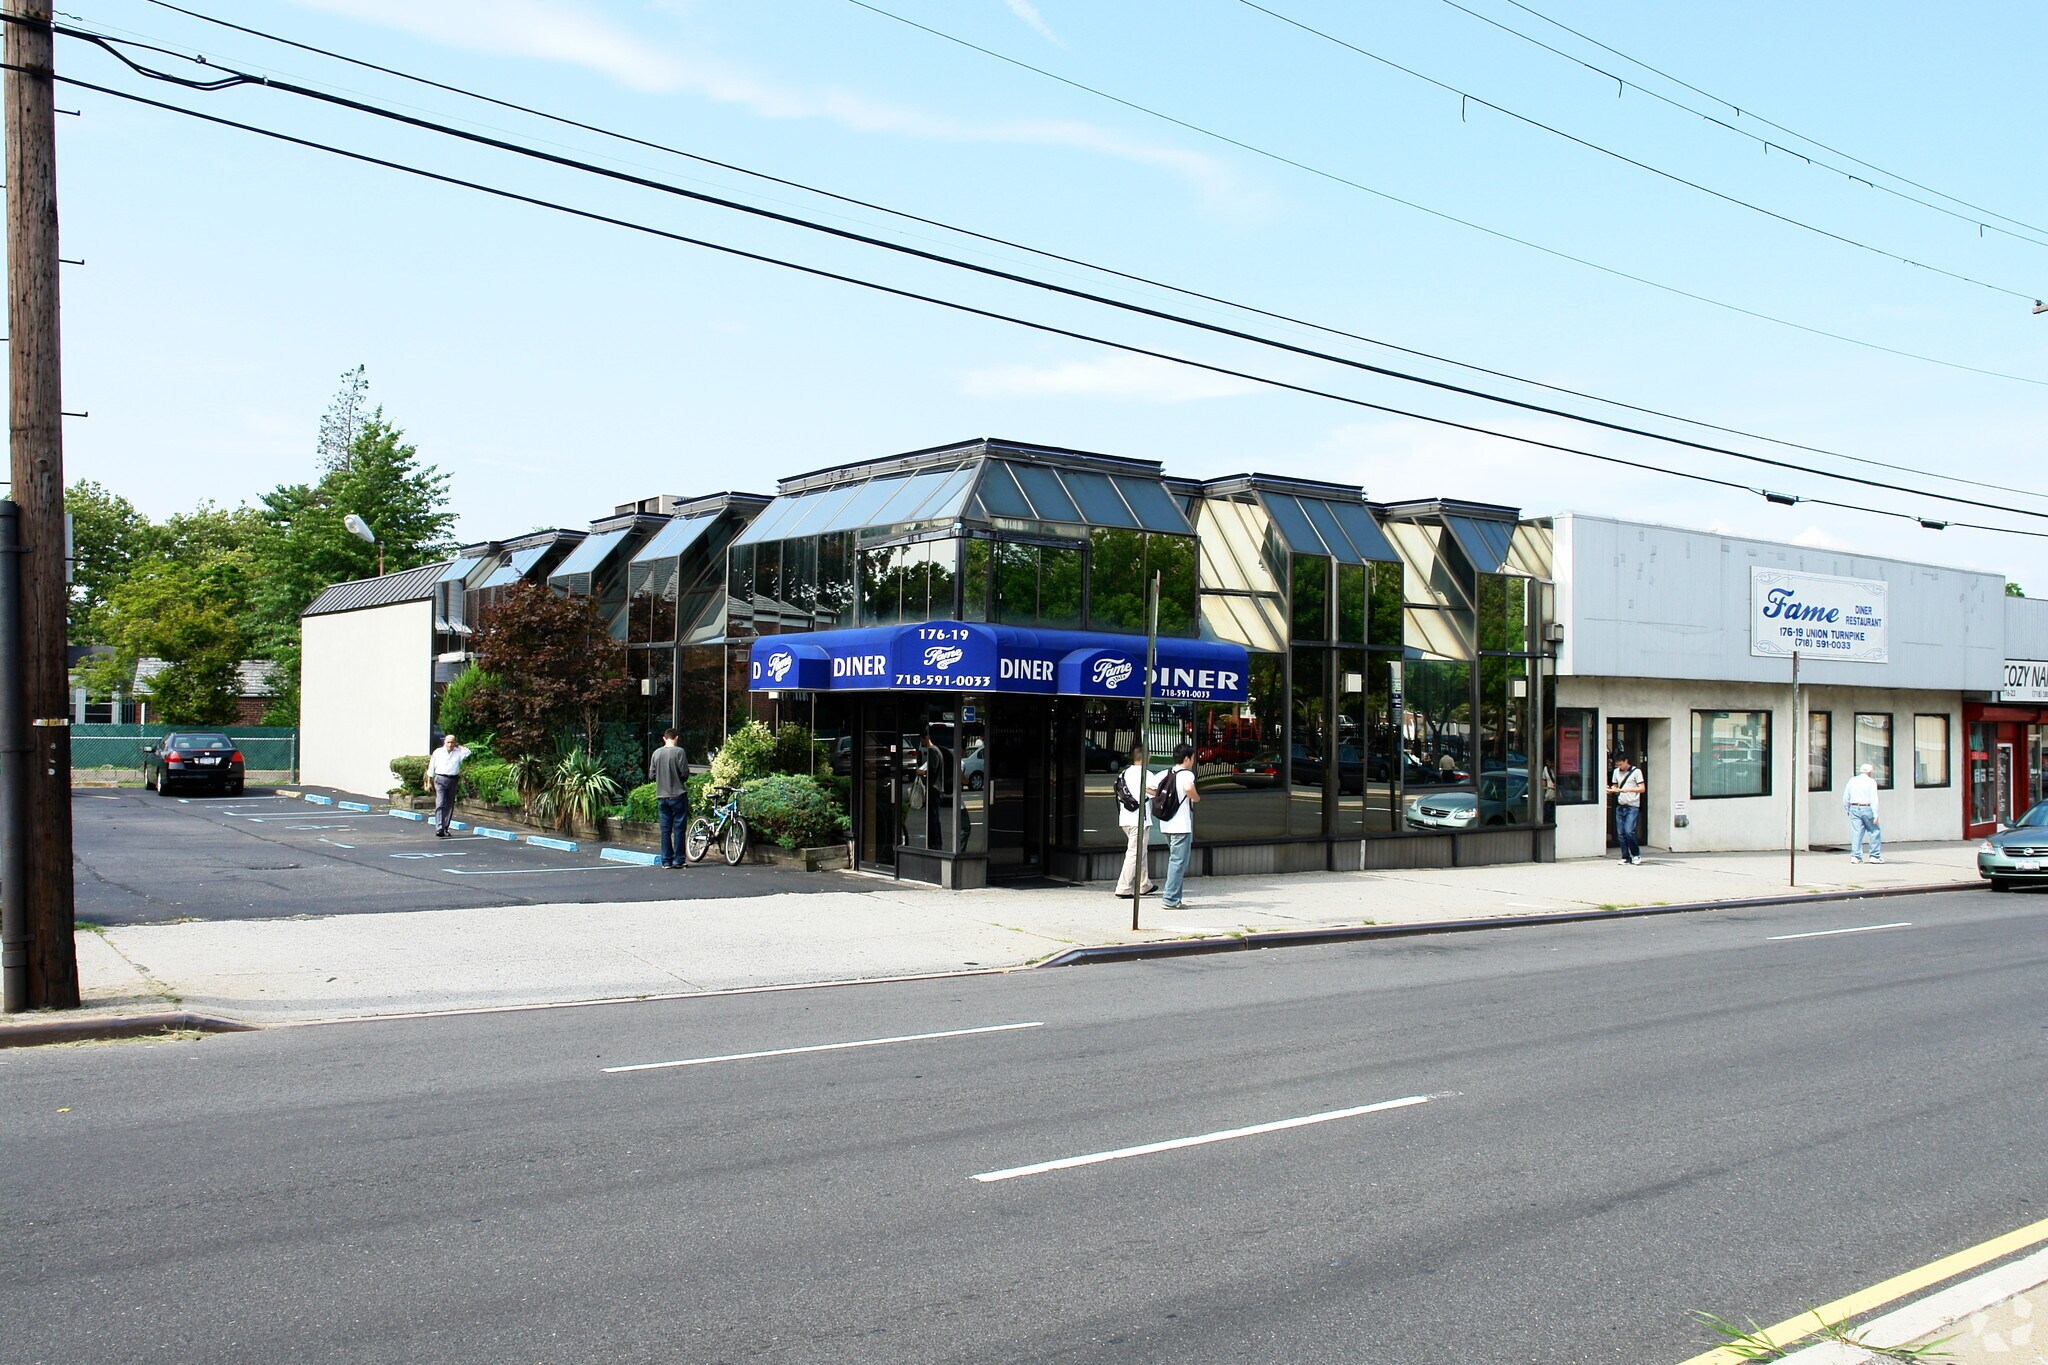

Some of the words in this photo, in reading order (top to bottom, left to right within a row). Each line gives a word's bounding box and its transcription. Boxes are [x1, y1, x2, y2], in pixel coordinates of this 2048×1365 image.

[1763, 588, 1839, 623] Fame
[1855, 605, 1872, 615] DINER
[1845, 616, 1882, 628] RESTAURANT
[919, 629, 969, 640] 176-19
[1780, 627, 1803, 637] 176-19
[1806, 629, 1828, 638] UNION
[1831, 630, 1865, 641] TURNPIKE
[1795, 638, 1813, 648] (718)
[1816, 641, 1851, 650] 591-0033
[924, 646, 963, 666] Fame
[833, 655, 886, 677] DINER
[1001, 658, 1053, 681] DINER
[1092, 658, 1132, 683] Fame
[896, 674, 991, 687] 718-591-0033
[1160, 689, 1210, 699] 718-591-0033
